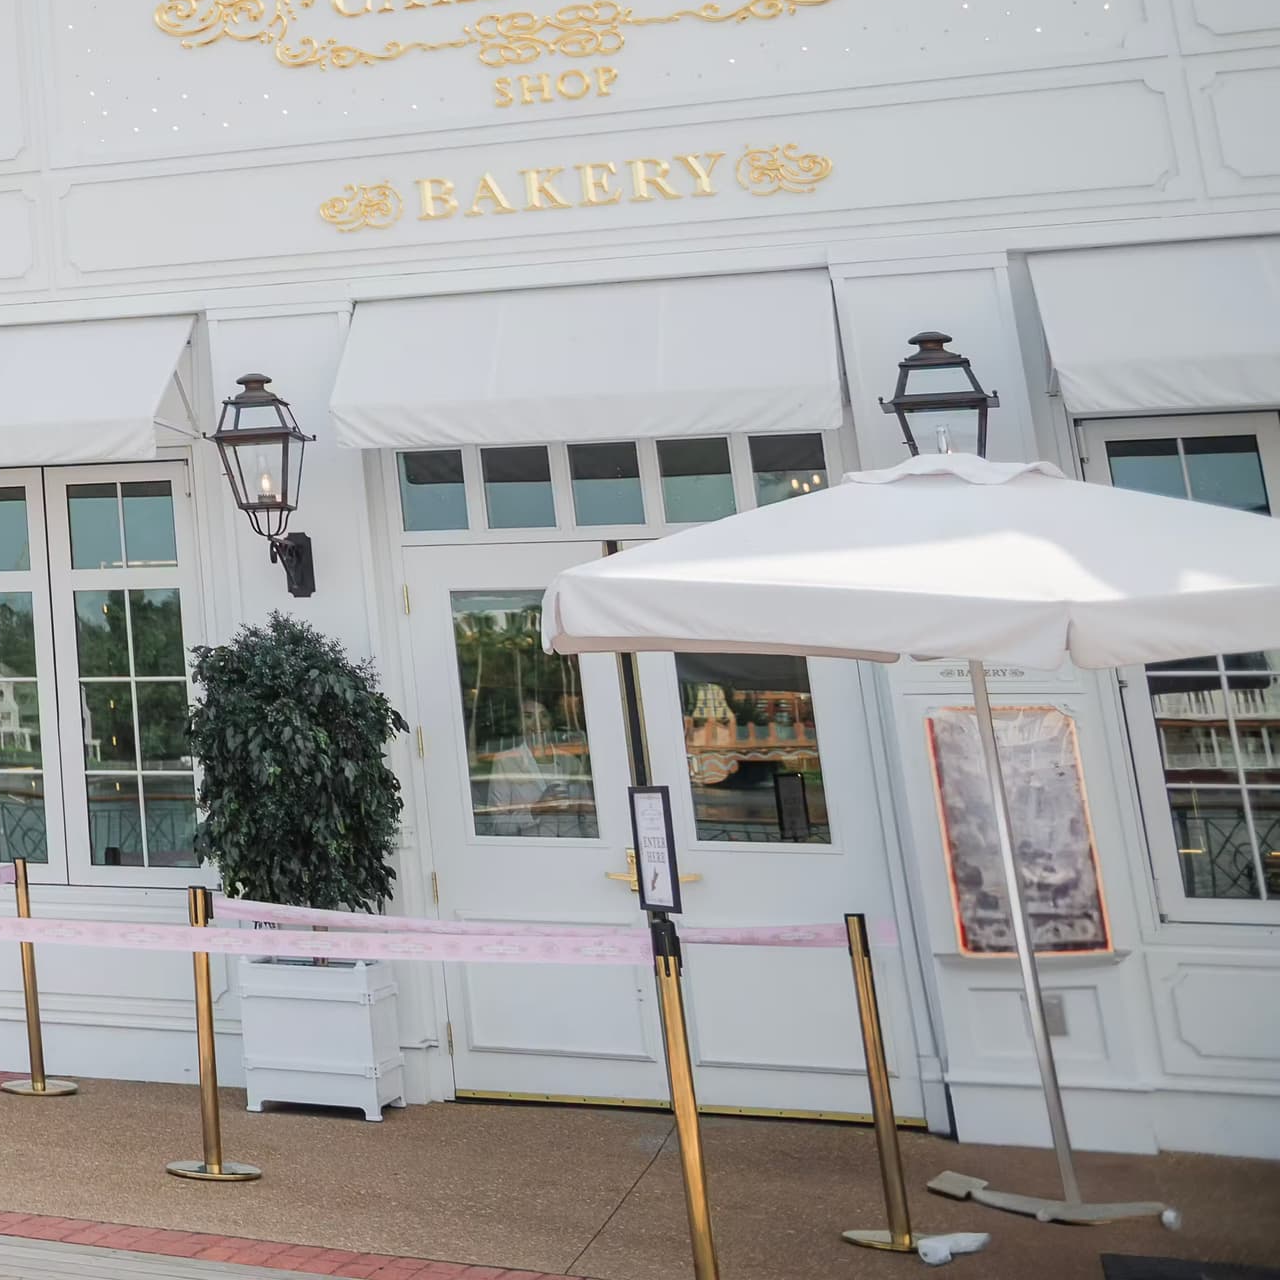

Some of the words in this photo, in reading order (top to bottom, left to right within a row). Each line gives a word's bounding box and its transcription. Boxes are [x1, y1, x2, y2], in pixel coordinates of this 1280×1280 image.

[493, 66, 619, 108] SHOP
[413, 151, 726, 221] BAKERY
[957, 669, 1008, 677] BERY
